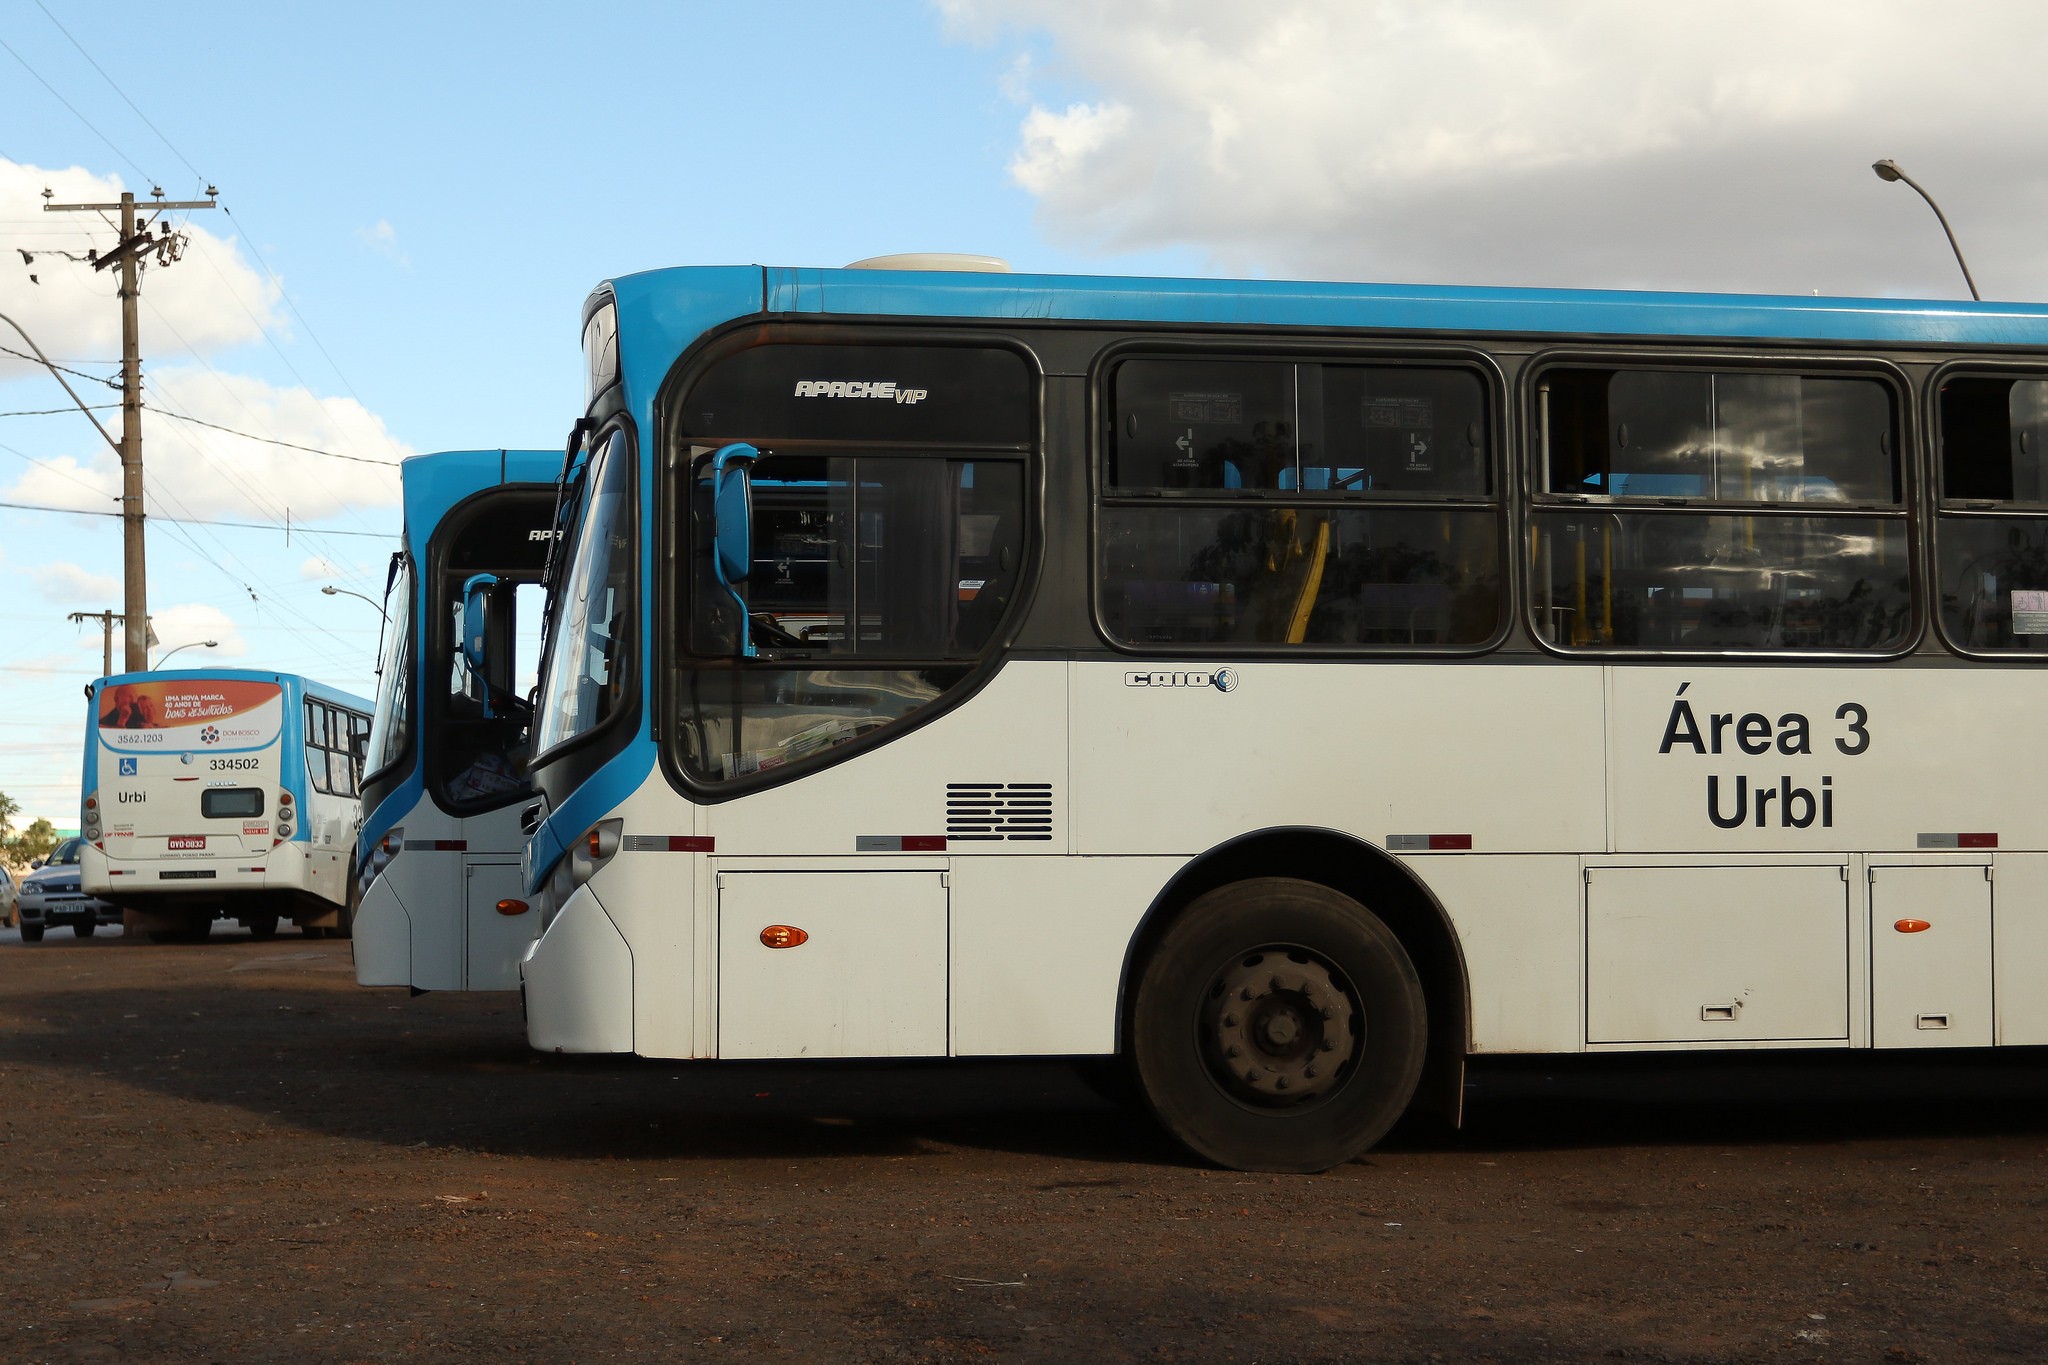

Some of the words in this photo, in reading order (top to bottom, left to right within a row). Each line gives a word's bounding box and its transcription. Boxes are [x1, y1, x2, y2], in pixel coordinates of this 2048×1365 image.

[795, 380, 897, 398] APACHE
[895, 389, 928, 404] VIP
[1124, 671, 1210, 687] CAIO
[1658, 682, 1812, 756] Área
[1833, 702, 1871, 756] 3
[117, 734, 163, 744] 3562.1203
[209, 758, 259, 771] 334502
[118, 791, 146, 804] Urbi
[1706, 774, 1834, 829] Urbi
